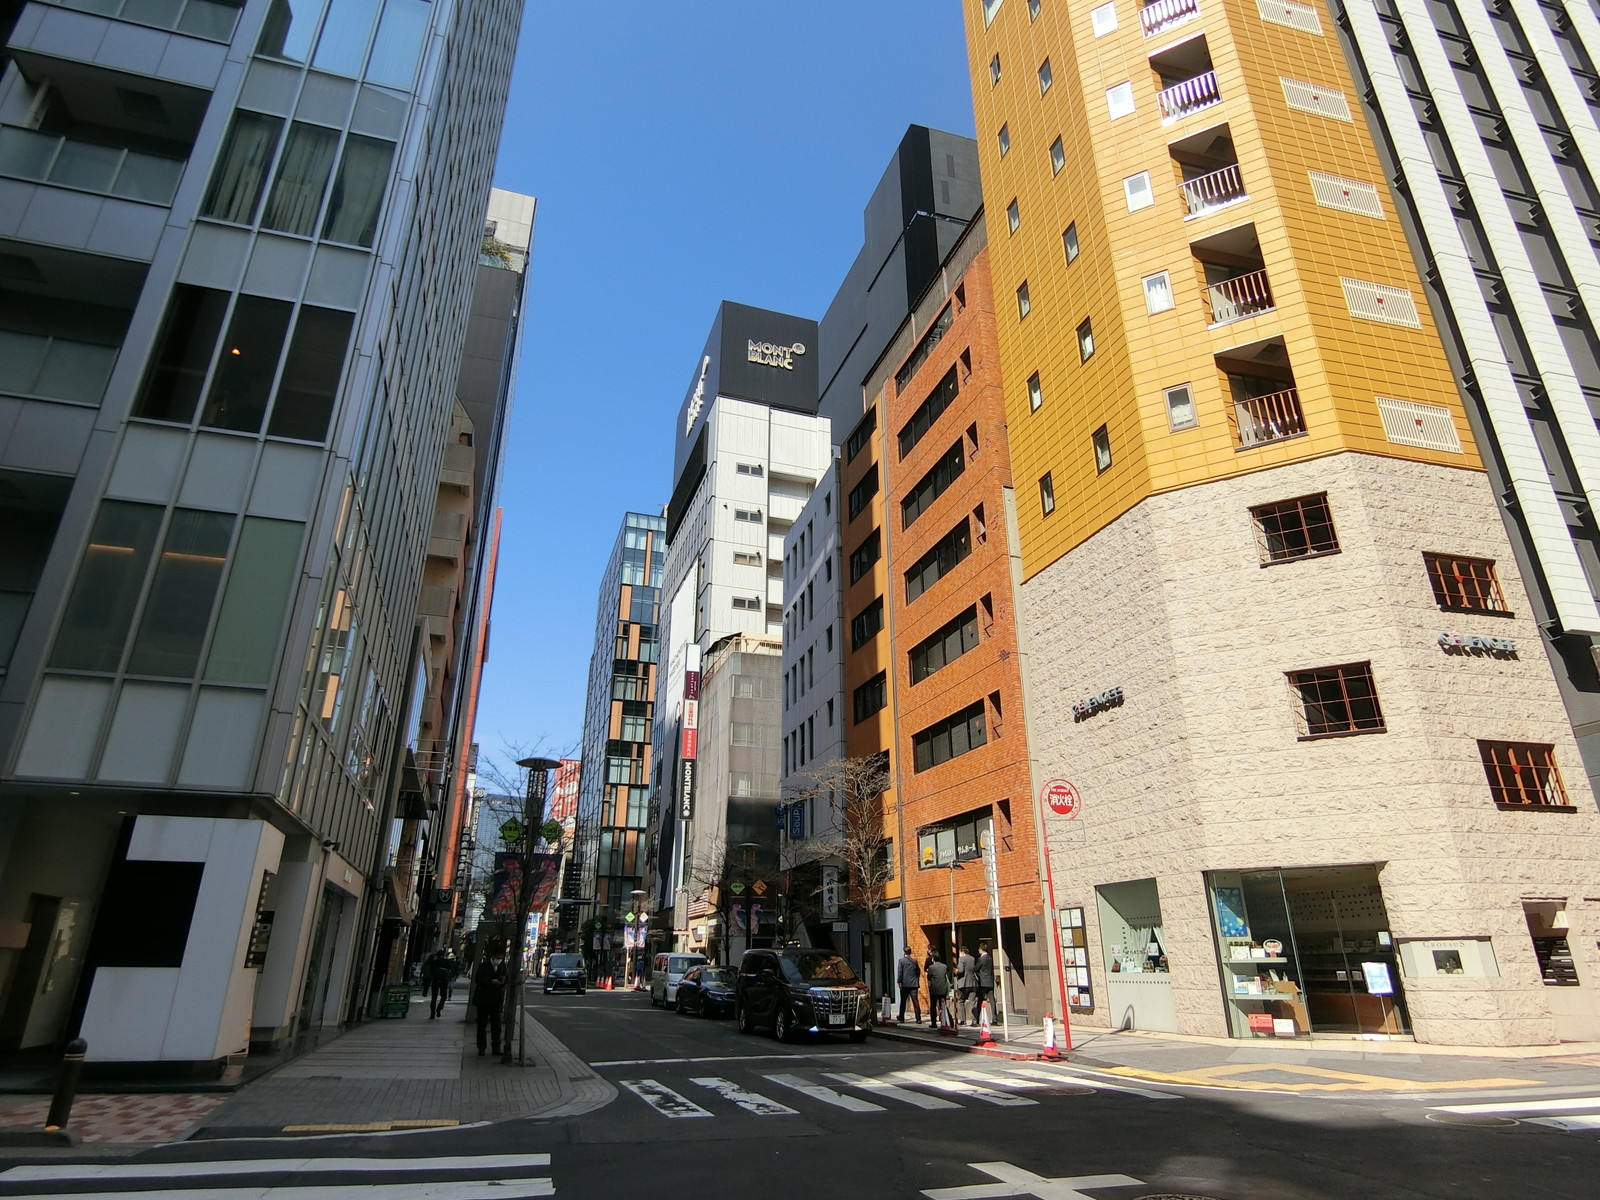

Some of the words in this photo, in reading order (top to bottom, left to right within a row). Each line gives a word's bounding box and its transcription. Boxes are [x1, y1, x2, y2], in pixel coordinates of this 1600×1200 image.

[748, 339, 793, 358] MONT
[748, 350, 793, 369] BLANC
[684, 762, 693, 810] MONTBLANC
[1049, 793, 1073, 806] 消火栓
